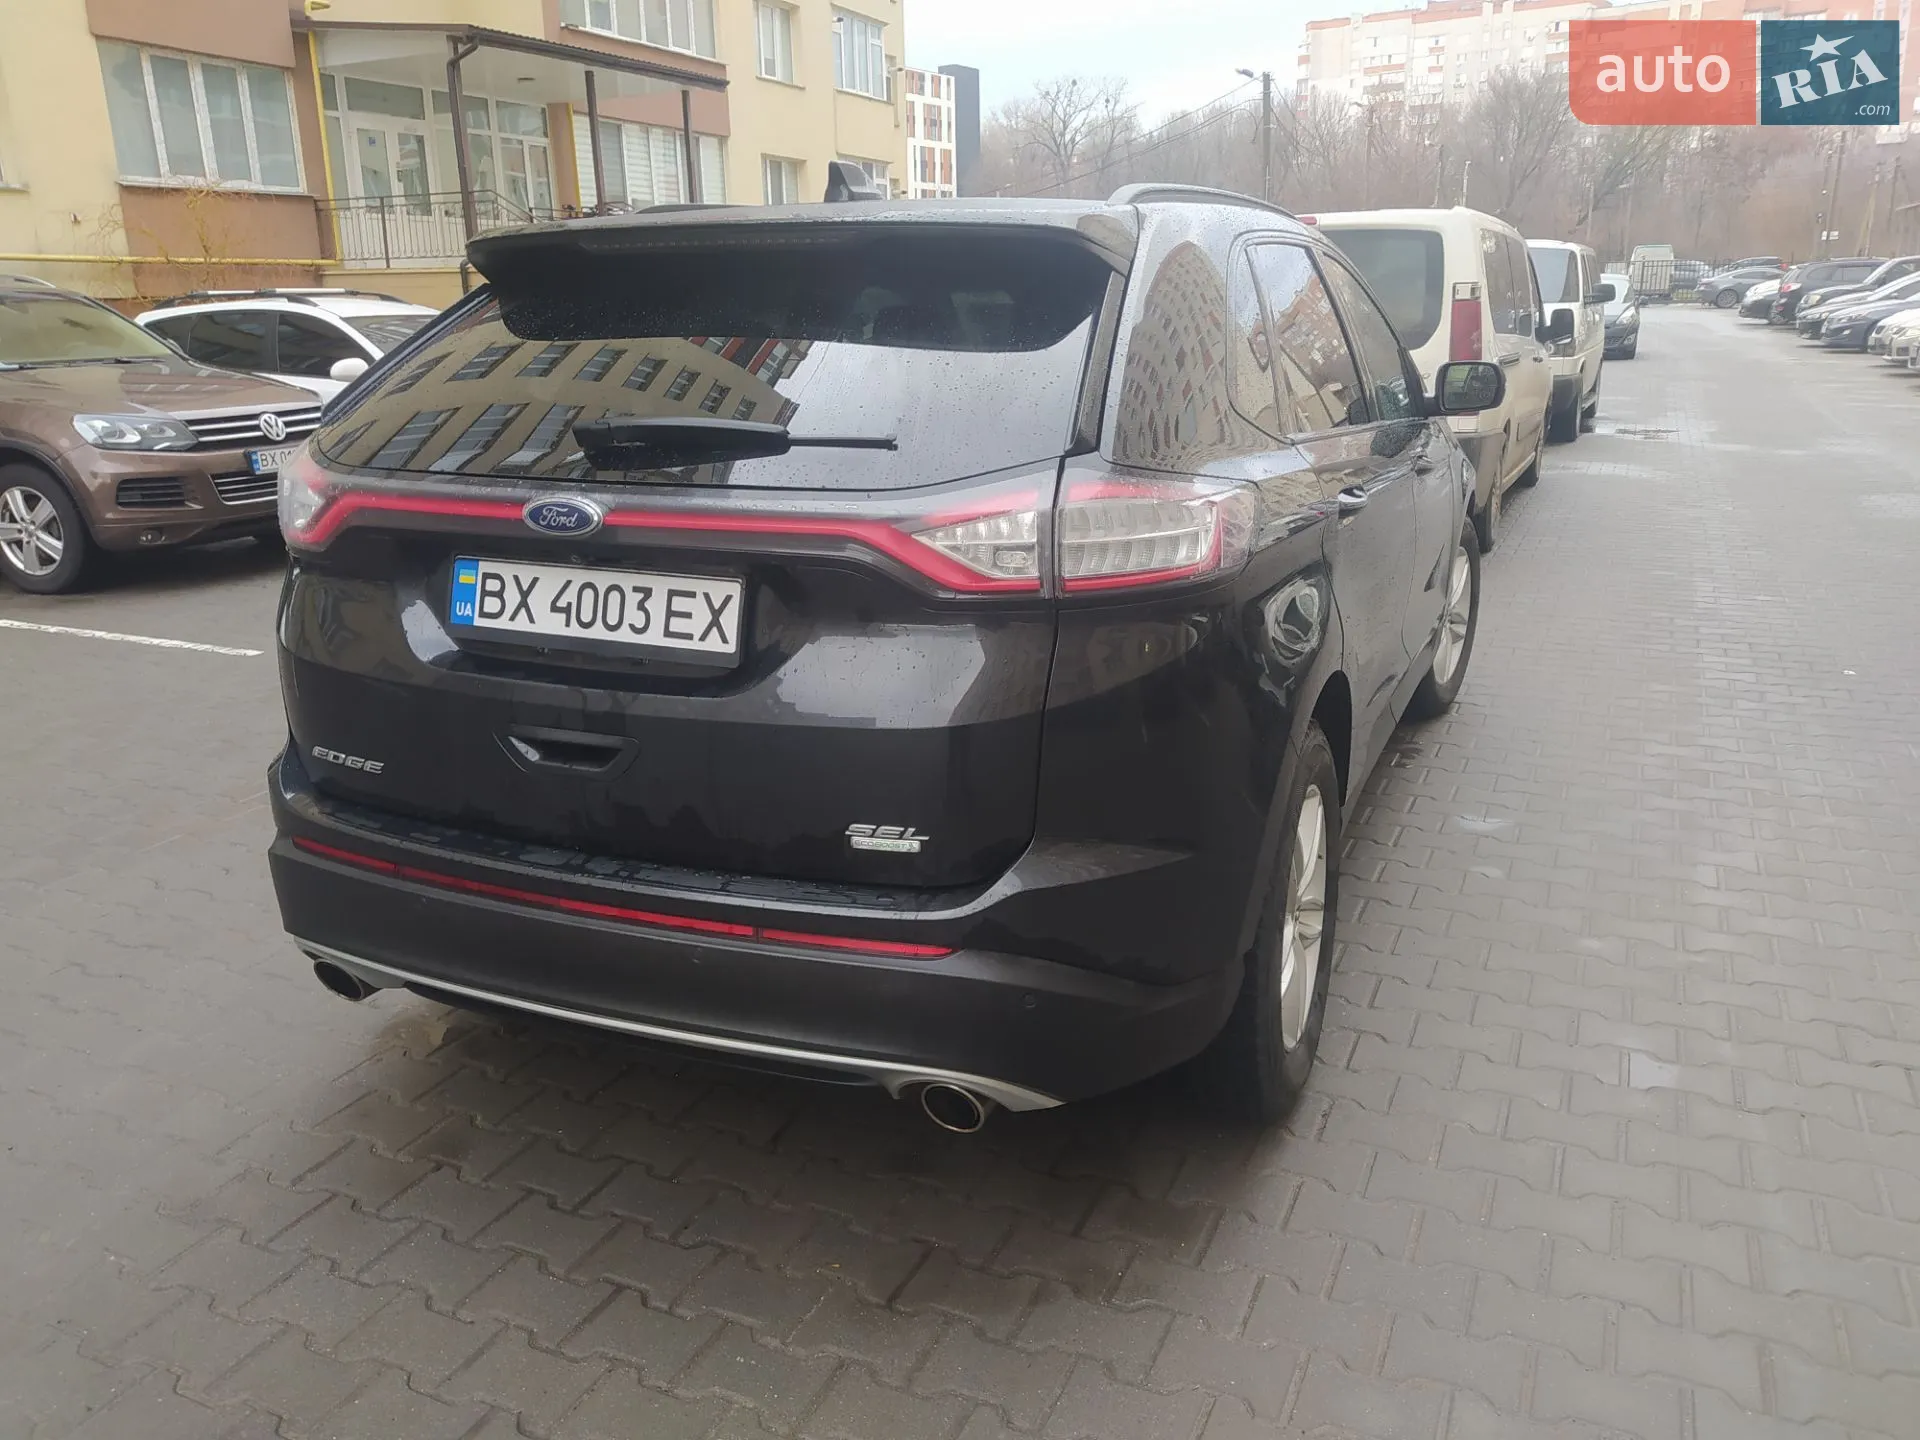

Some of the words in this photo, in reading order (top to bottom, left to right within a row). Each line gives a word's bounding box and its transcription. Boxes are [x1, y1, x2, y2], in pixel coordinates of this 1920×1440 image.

[539, 505, 579, 528] Ford
[456, 601, 473, 617] UA
[478, 572, 540, 624] BX
[550, 579, 653, 635] 4003
[663, 588, 733, 645] EX
[312, 745, 385, 774] EDGE
[844, 823, 930, 841] SEL
